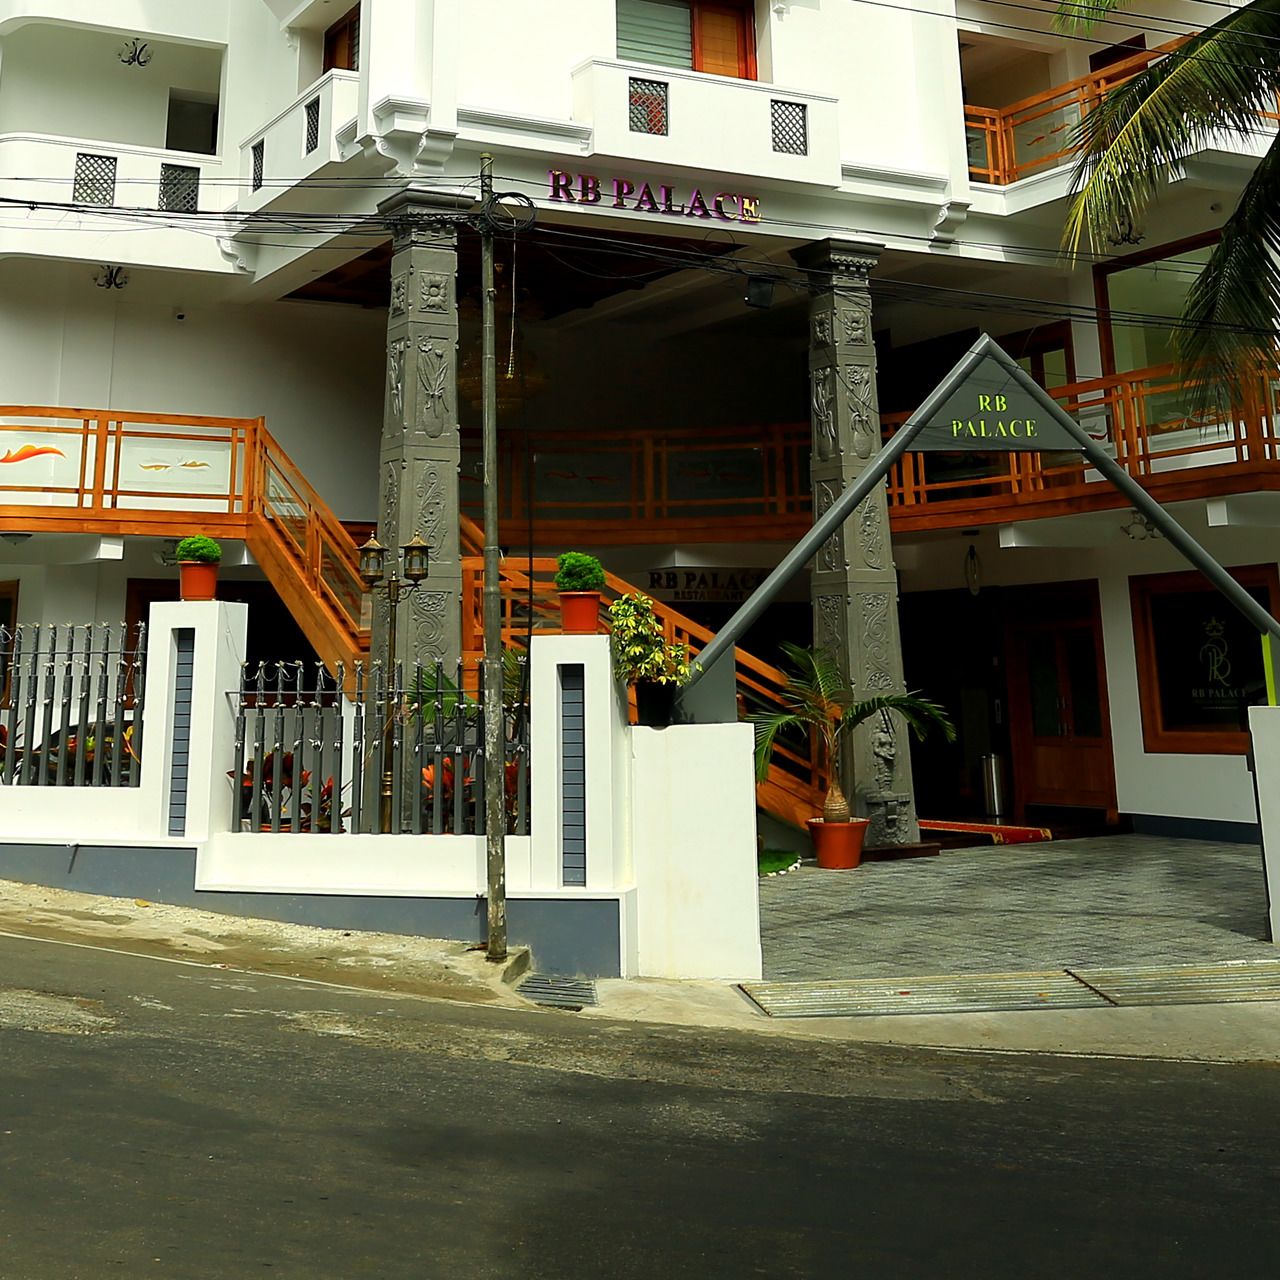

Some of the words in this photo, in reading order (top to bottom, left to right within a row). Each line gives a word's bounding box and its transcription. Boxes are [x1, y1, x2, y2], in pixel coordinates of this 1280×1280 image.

[548, 169, 602, 203] RB
[612, 178, 762, 224] PALACE
[978, 394, 1007, 412] RB
[952, 419, 1038, 437] PALACE
[648, 572, 678, 589] RB
[1191, 687, 1206, 698] RB
